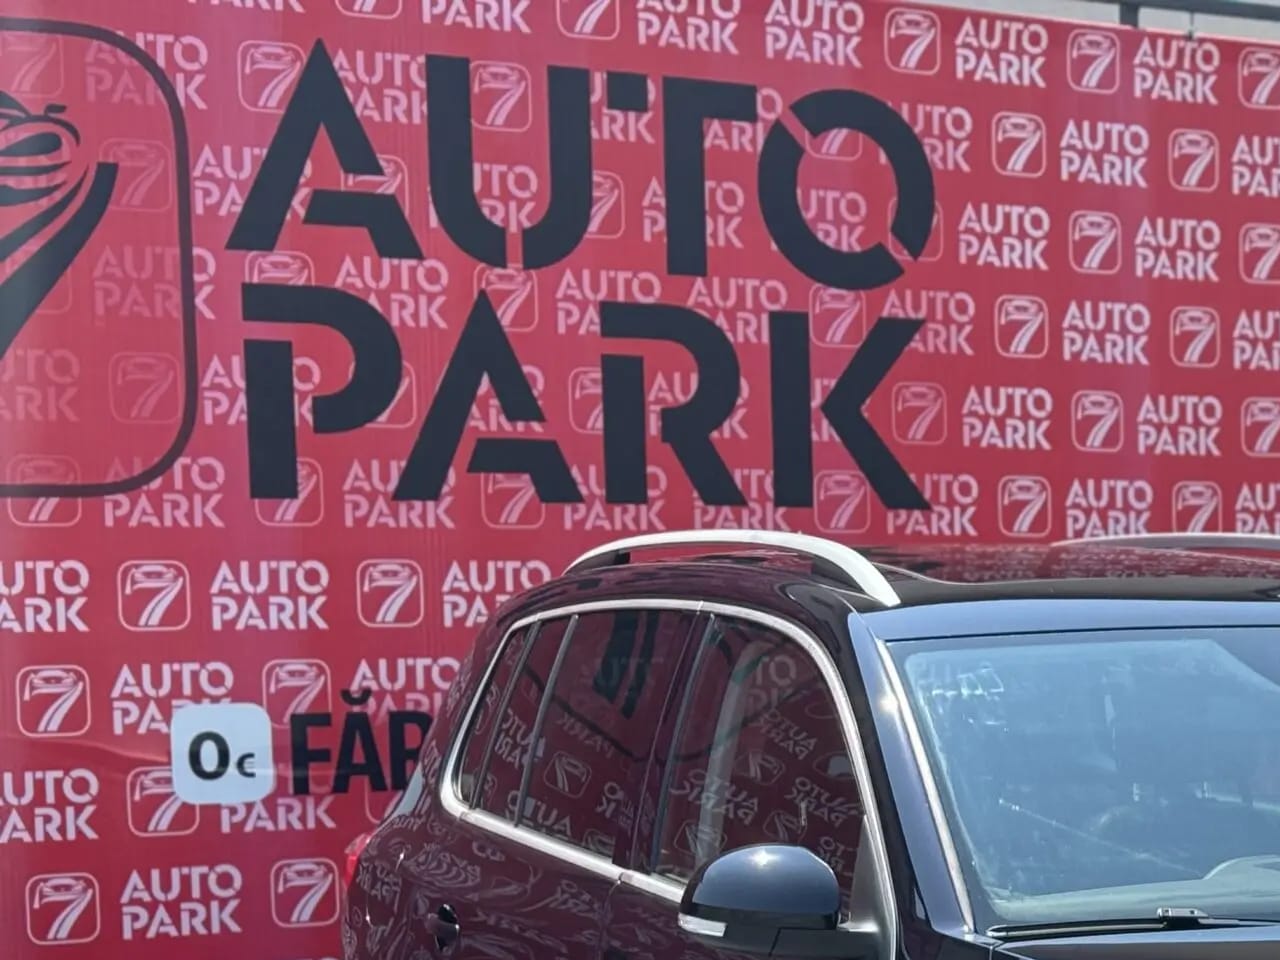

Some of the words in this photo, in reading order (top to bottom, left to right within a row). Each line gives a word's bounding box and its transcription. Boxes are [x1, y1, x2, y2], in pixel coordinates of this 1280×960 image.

[637, 11, 739, 55] PARK
[764, 0, 864, 34] AUTO
[765, 25, 862, 68] PARK
[955, 19, 1048, 55] AUTO
[1133, 37, 1220, 73] AUTO
[955, 47, 1046, 88] PARK
[1133, 67, 1218, 105] PARK
[904, 104, 973, 140] UTO
[1060, 119, 1149, 156] AUTO
[226, 37, 935, 291] AUTO
[1060, 150, 1148, 189] PARK
[795, 185, 867, 223] UTO
[958, 202, 1050, 238] AUTO
[1135, 216, 1221, 250] AUTO
[959, 233, 1049, 271] PARK
[1135, 247, 1219, 282] PARK
[333, 255, 449, 293] AUTO
[555, 268, 662, 304] AUTO
[686, 276, 788, 318] AUTO
[1062, 300, 1151, 334] AUTO
[909, 323, 975, 356] ARK
[1062, 330, 1149, 366] PARK
[241, 282, 932, 509] PARK
[962, 386, 1053, 419] AUTO
[1137, 394, 1223, 426] AUTO
[962, 416, 1052, 451] PARK
[1137, 424, 1221, 457] PARK
[908, 473, 979, 505] UTO
[1065, 478, 1153, 509] AUTO
[103, 493, 225, 528] PARK
[563, 498, 666, 531] PARK
[887, 505, 978, 537] PARK
[1066, 512, 1149, 537] PARK
[0, 559, 90, 595] UTO
[210, 560, 330, 594] AUTO
[441, 559, 552, 593] AUTO
[212, 595, 329, 631] PARK
[110, 661, 234, 698] AUTO
[0, 768, 100, 806] UTO
[0, 804, 99, 844] ARK
[221, 797, 338, 834] PARK
[120, 863, 243, 904] AUTO
[121, 899, 242, 940] PARK
